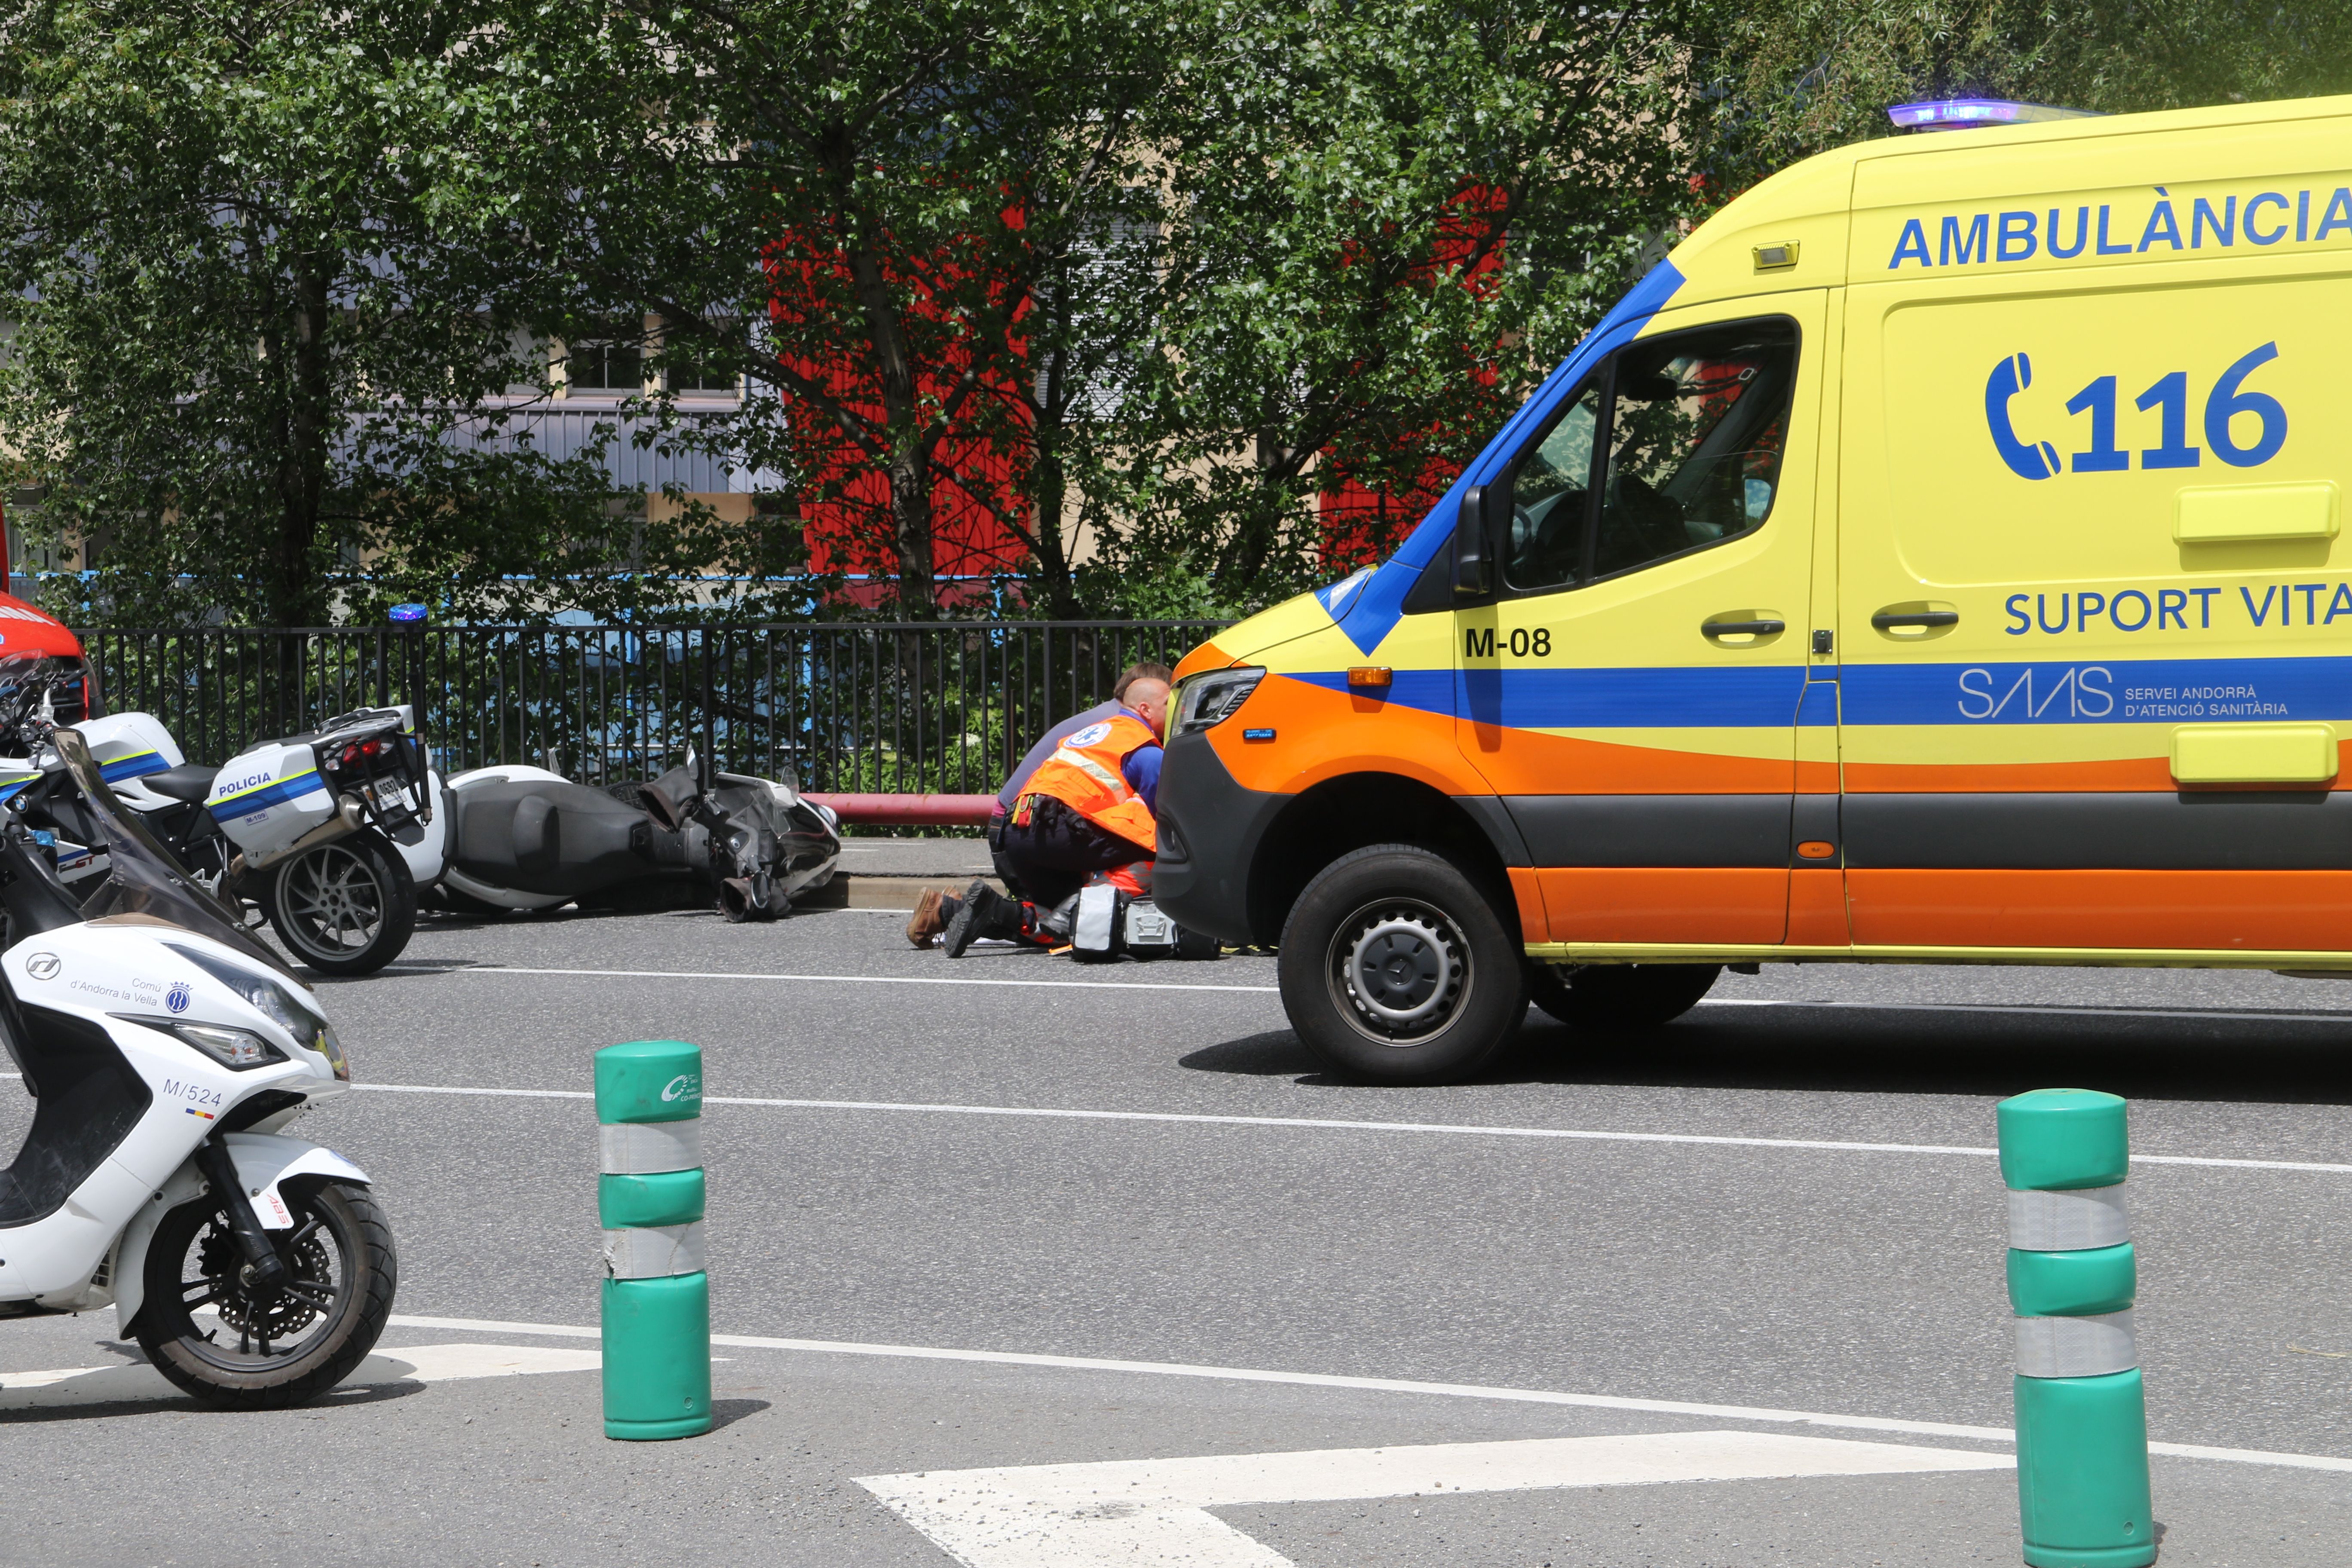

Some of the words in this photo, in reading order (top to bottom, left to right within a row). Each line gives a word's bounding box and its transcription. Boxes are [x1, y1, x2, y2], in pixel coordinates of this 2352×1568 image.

[1888, 186, 2352, 269] AMBULÀNCIA
[2065, 341, 2288, 473] 116
[2005, 587, 2221, 635] SUPORT
[1466, 628, 1551, 657] M-08
[2125, 689, 2176, 700] SERVEI
[2182, 684, 2257, 699] ANDORRÀ
[2210, 701, 2288, 715] SANITÀRIA
[219, 772, 271, 796] POLICIA
[379, 780, 398, 798] 0692
[246, 813, 266, 823] M-109
[132, 978, 162, 992] Comú
[122, 990, 130, 1000] la
[134, 993, 158, 1006] Vella
[163, 1079, 221, 1107] M/524
[267, 1194, 289, 1224] ABS
